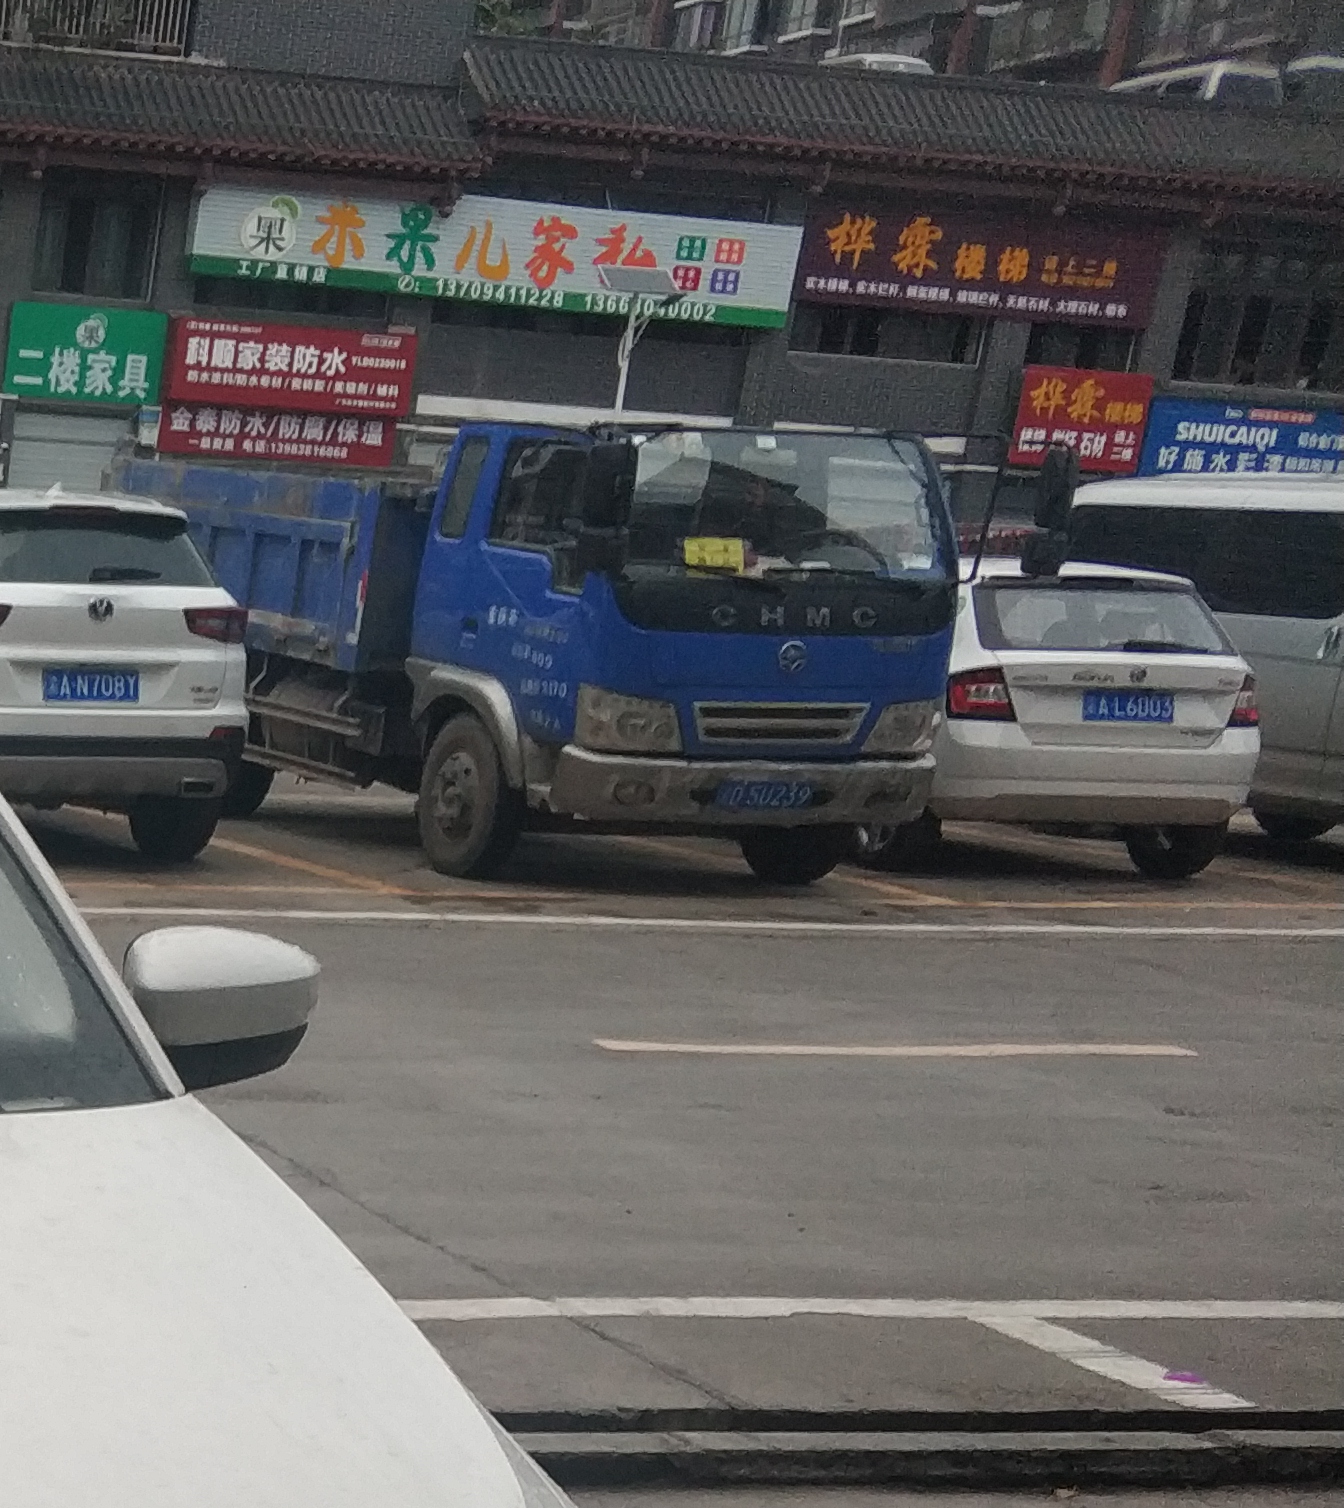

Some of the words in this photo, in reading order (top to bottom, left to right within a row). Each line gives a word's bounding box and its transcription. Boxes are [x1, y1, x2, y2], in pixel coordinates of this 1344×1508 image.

[237, 260, 327, 284] 工厂直销店
[435, 278, 564, 306] 13709411228
[584, 293, 716, 321] 136600002
[13, 347, 149, 399] 二楼家具
[185, 336, 348, 377] 科顺家装防水
[1174, 421, 1278, 452] SHUICAIQI
